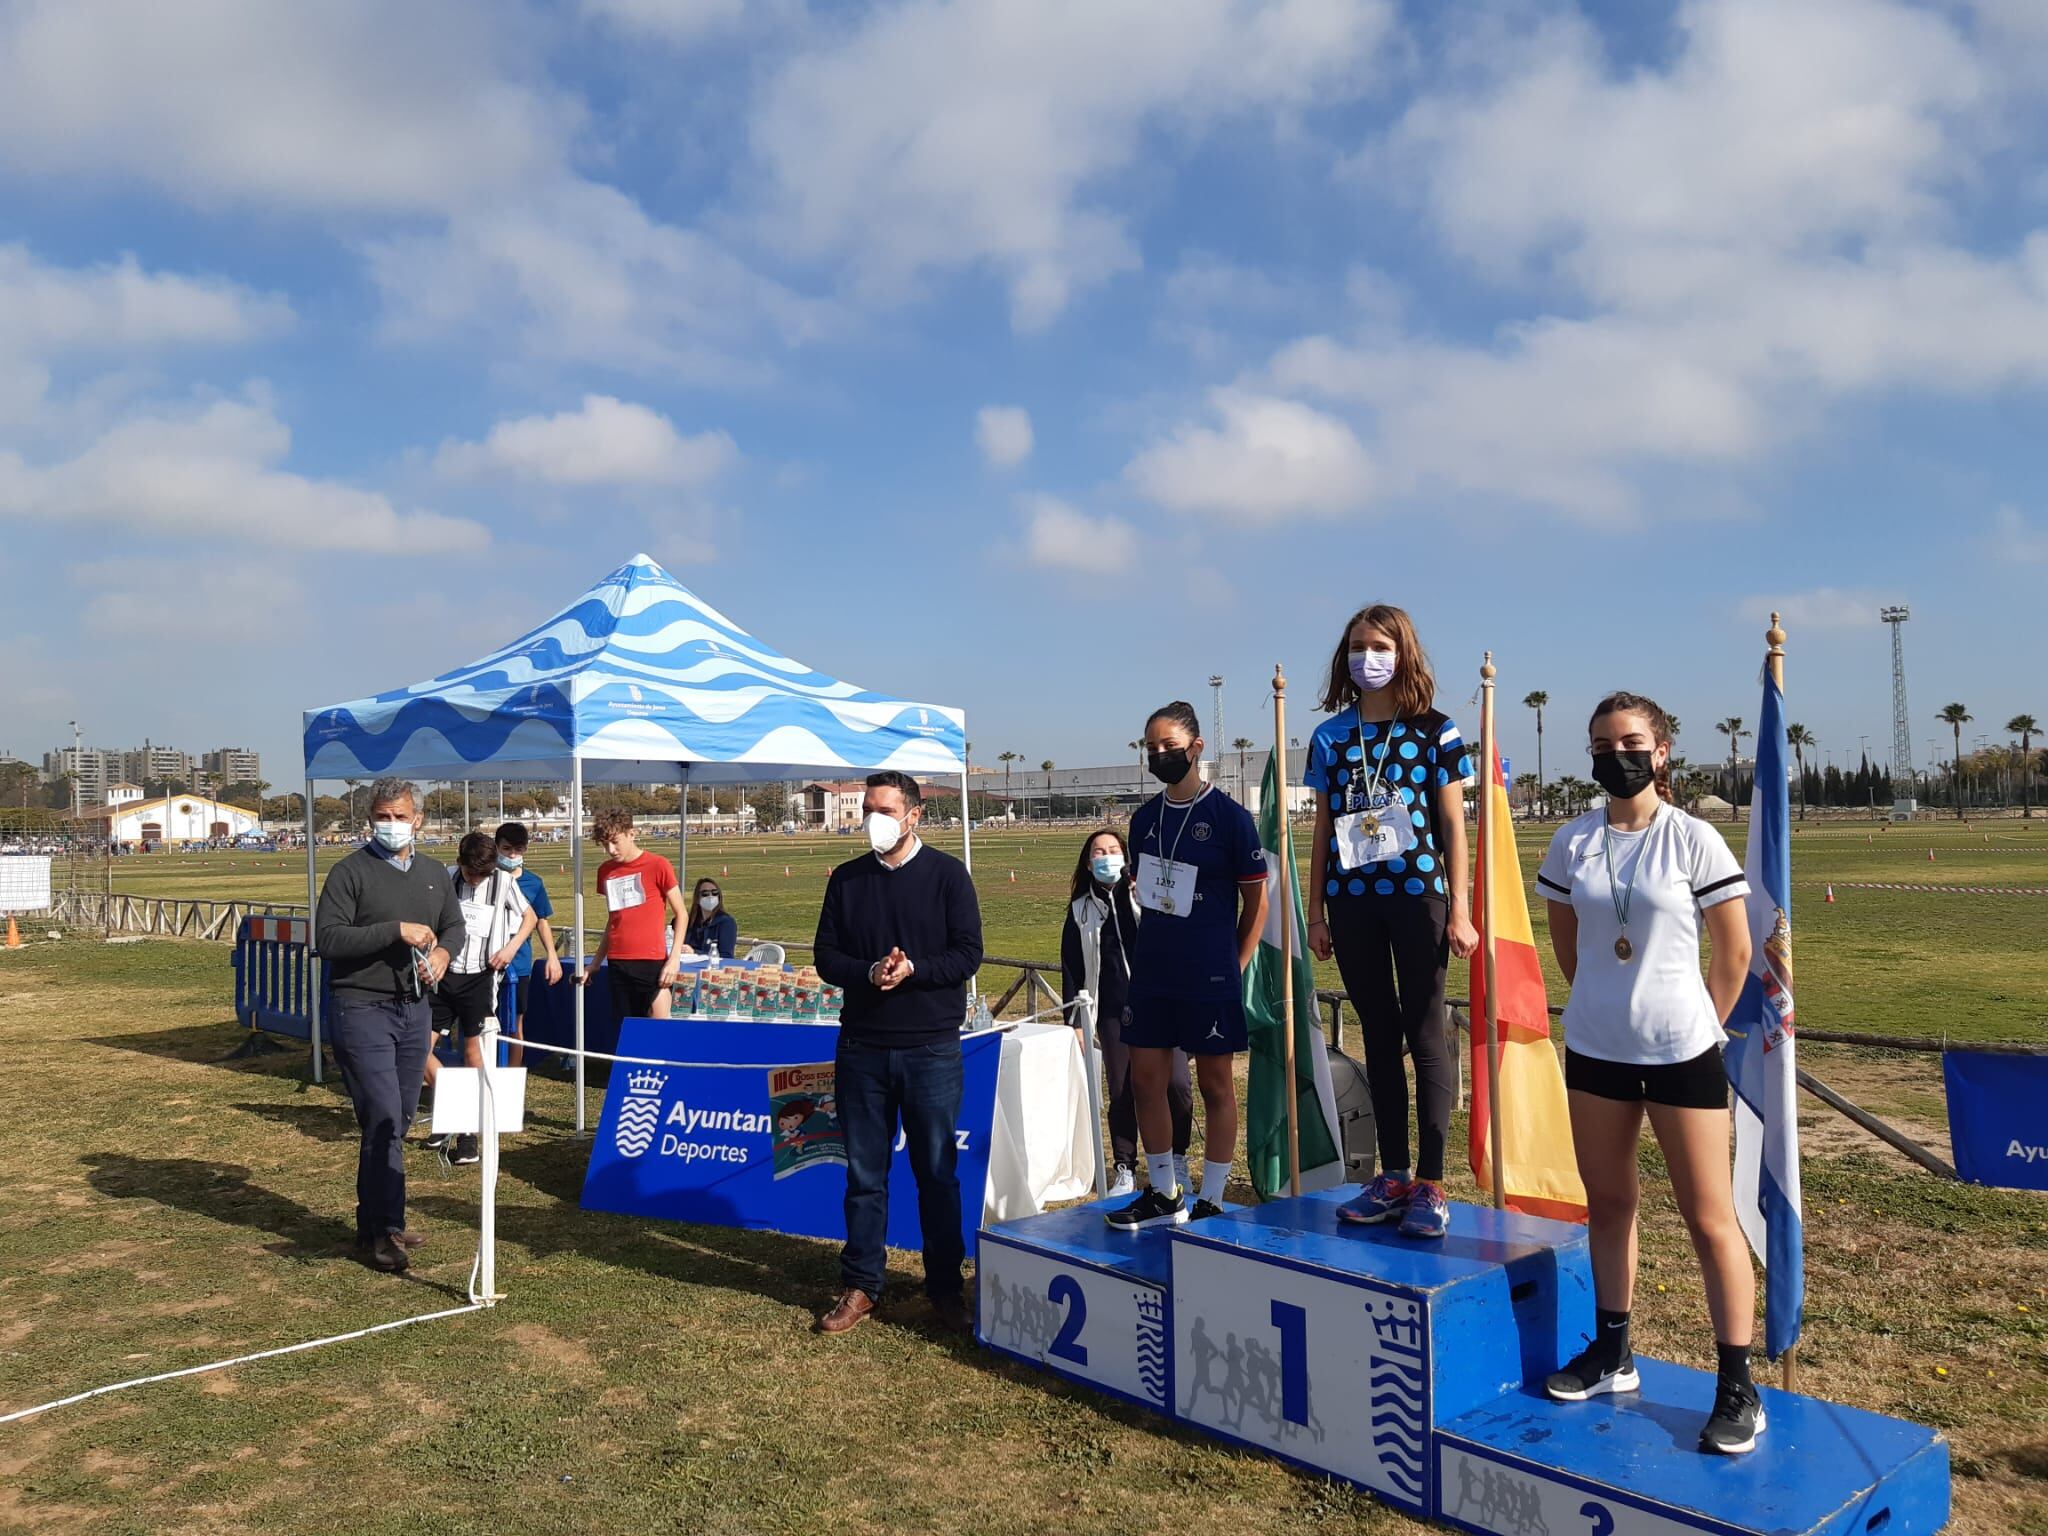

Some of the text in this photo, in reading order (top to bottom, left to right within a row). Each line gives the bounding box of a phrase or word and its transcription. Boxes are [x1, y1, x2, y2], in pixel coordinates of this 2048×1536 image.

[661, 1133, 748, 1164] Deportes
[1048, 1274, 1088, 1366] 2
[1271, 1299, 1308, 1427] 1
